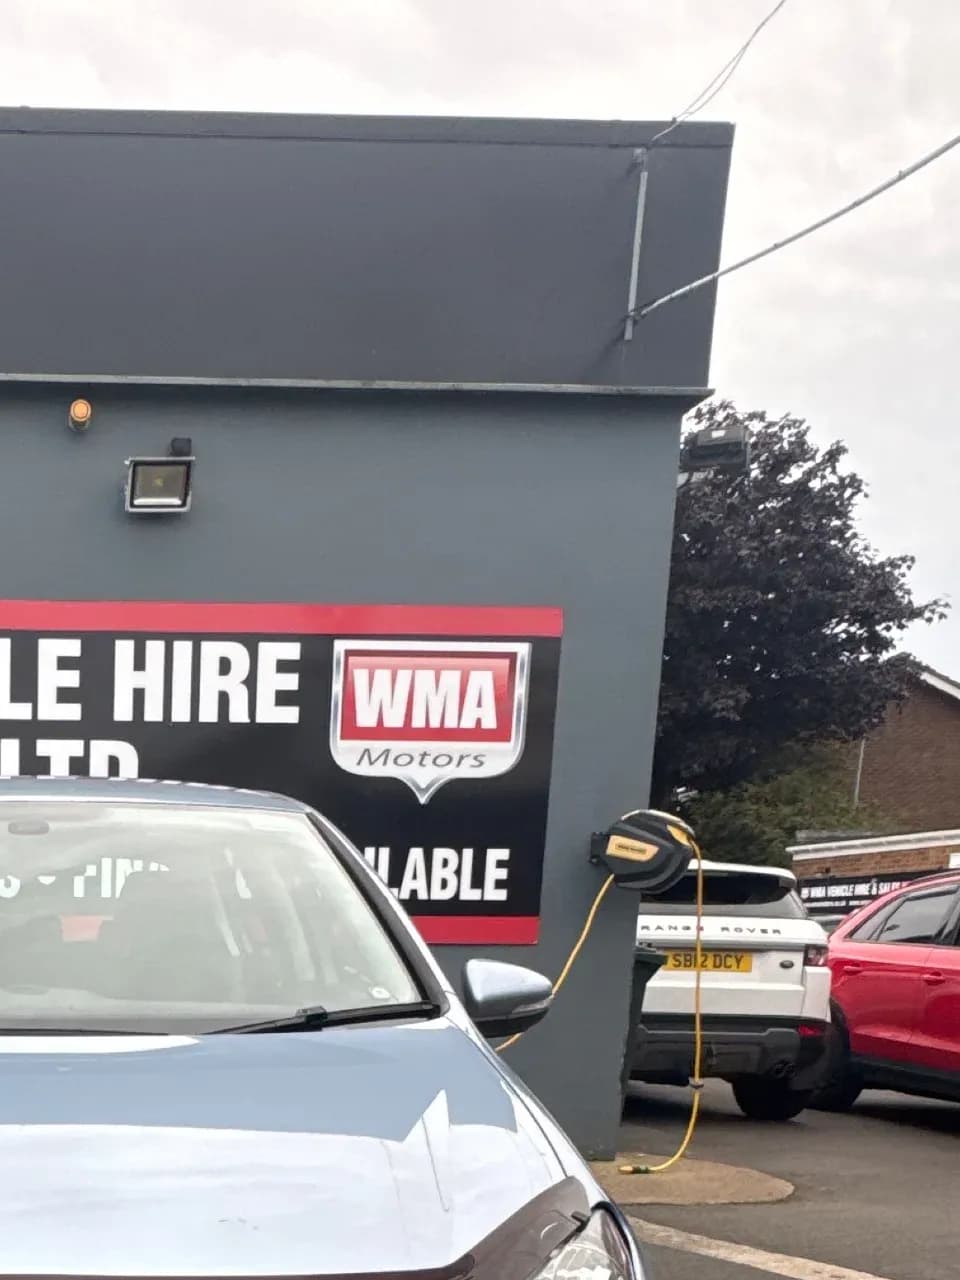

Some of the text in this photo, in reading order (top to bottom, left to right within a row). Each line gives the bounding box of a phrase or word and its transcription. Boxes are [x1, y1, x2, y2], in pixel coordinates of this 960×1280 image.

[113, 639, 302, 724] HIRE
[352, 668, 498, 730] WMA
[356, 746, 486, 768] Motors
[720, 926, 782, 935] ROVER
[713, 953, 745, 969] DCY
